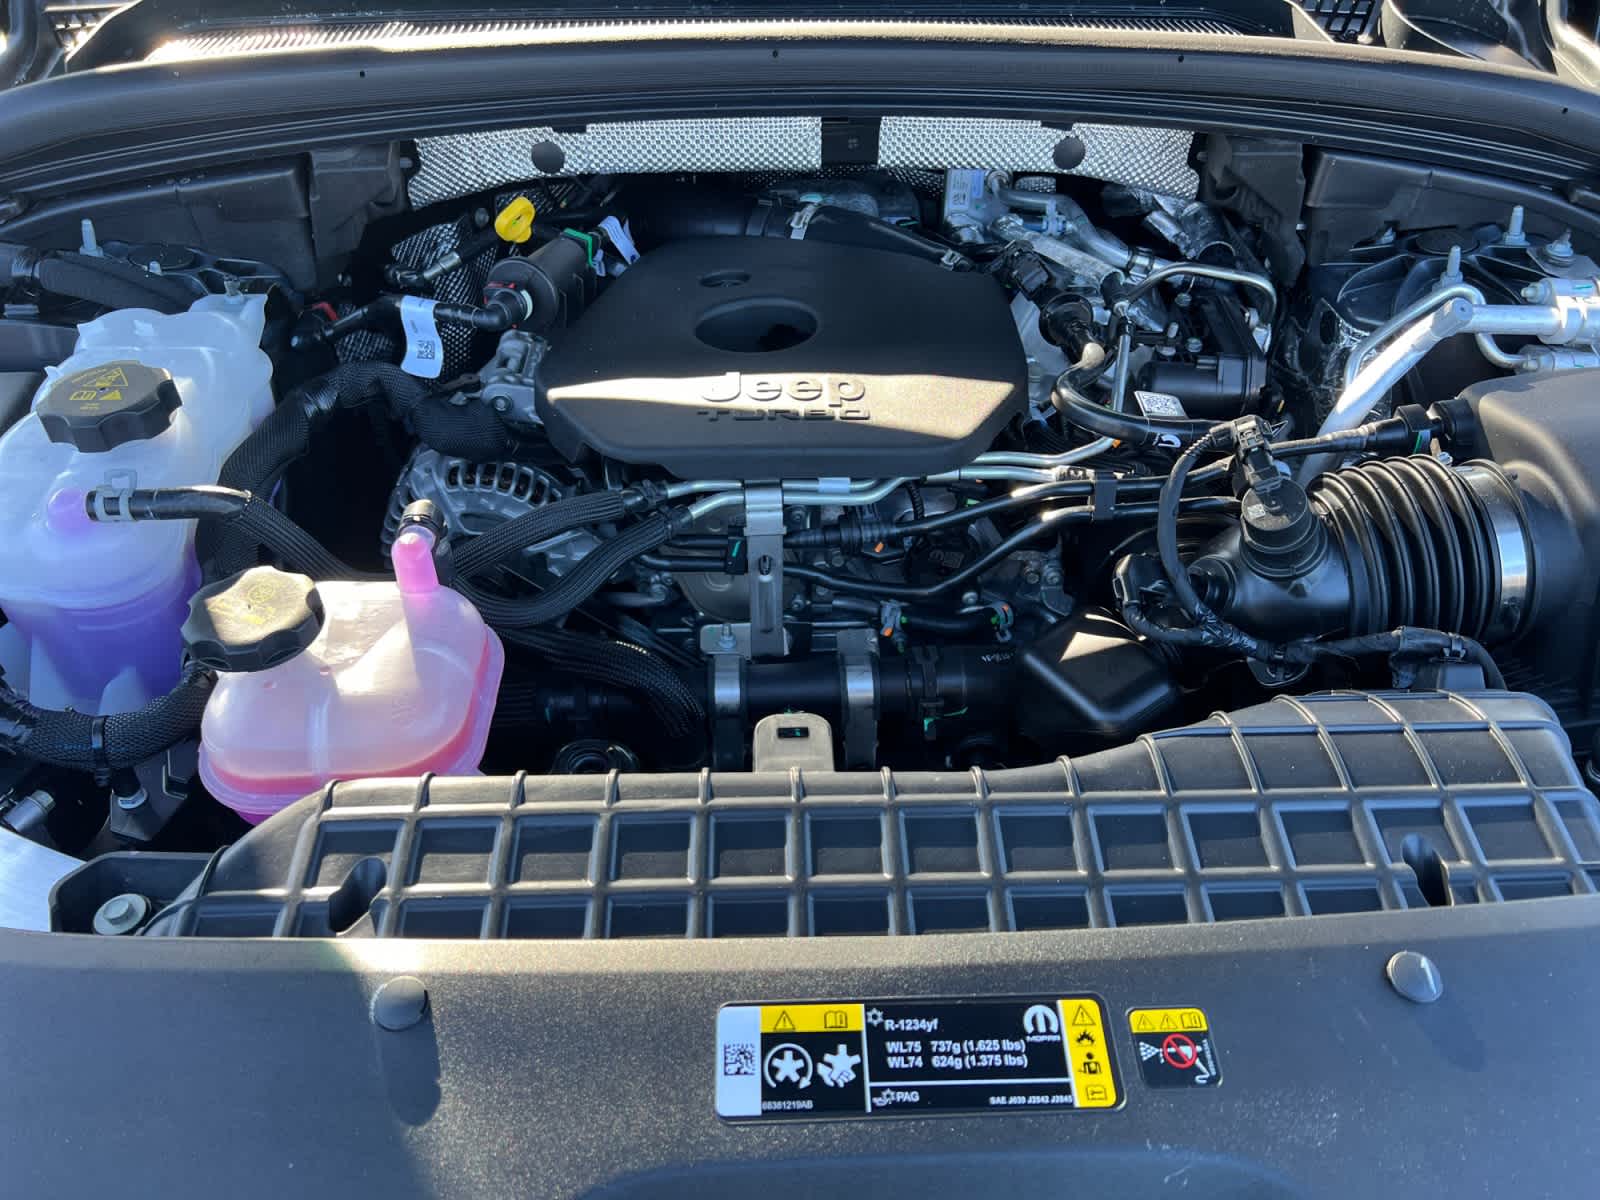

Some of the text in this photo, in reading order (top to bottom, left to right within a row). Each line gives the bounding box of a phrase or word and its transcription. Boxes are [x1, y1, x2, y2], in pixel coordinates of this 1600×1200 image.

[701, 371, 866, 407] Jeep
[884, 1018, 939, 1033] R-1234yf
[886, 1039, 1026, 1055] WL75 737g (1.625 lbs)
[887, 1053, 1028, 1070] WL74 624g (1.375 lbs)
[895, 1090, 920, 1103] PAG
[990, 1095, 1007, 1105] SAE
